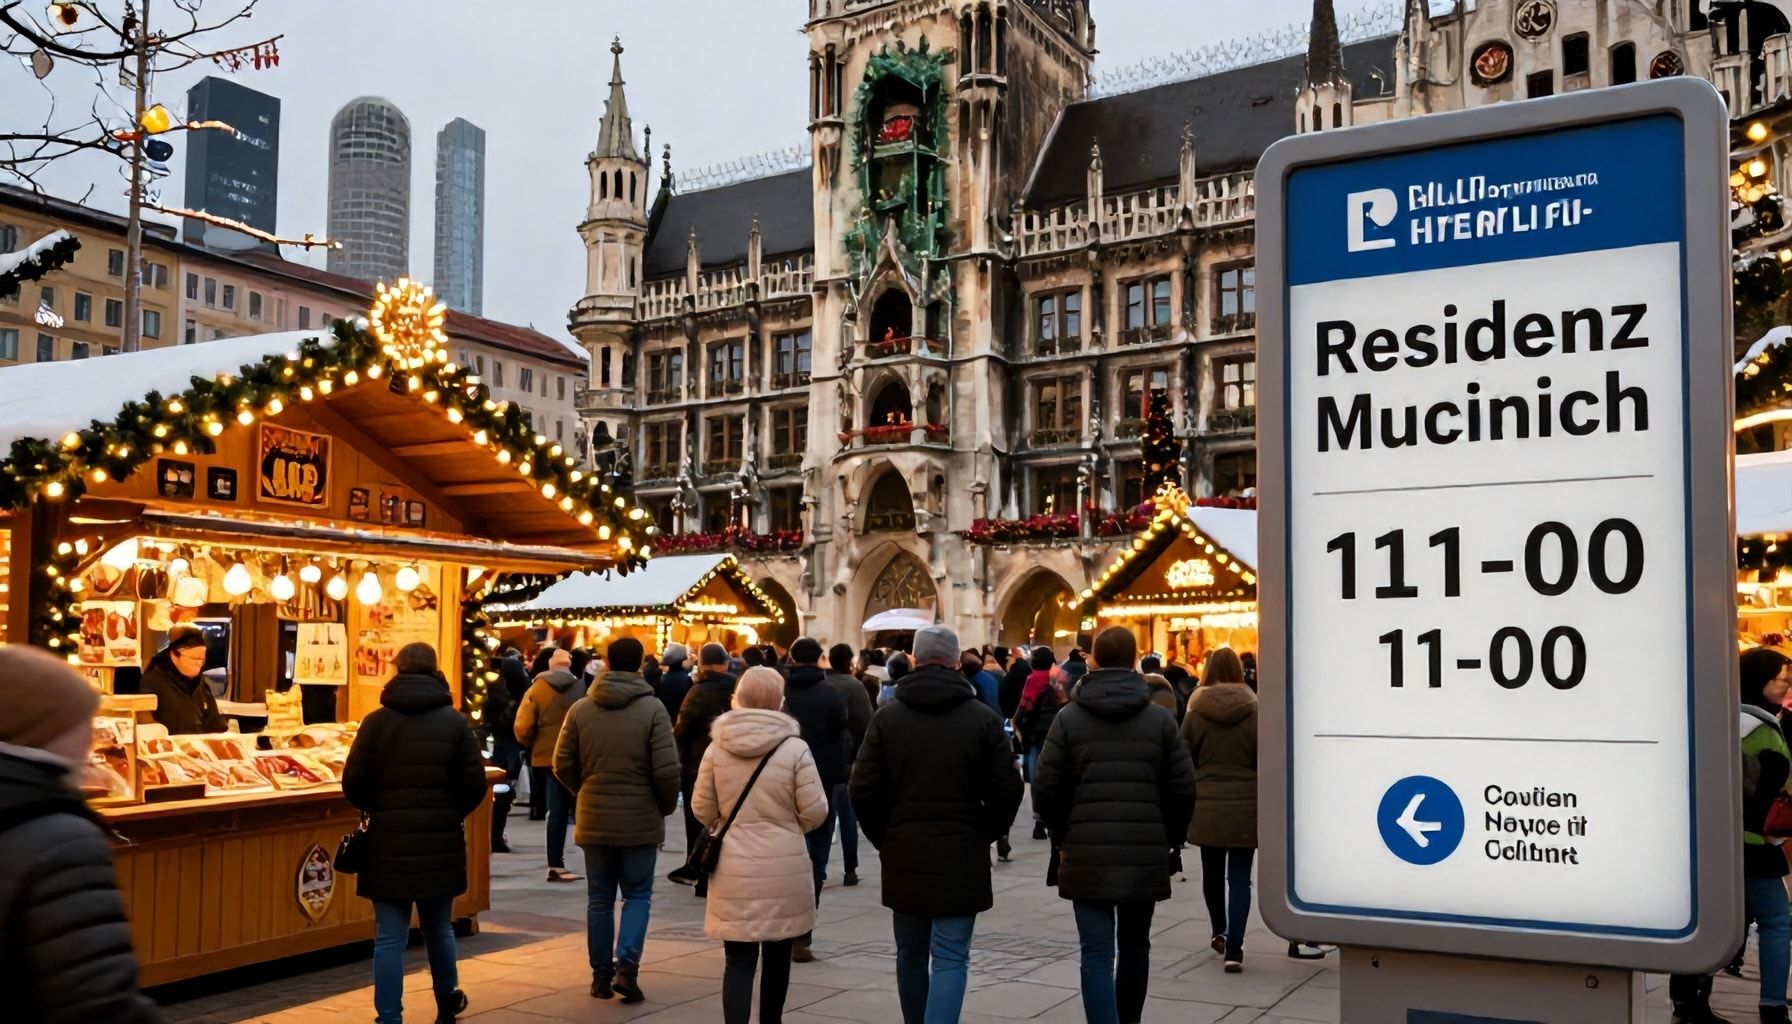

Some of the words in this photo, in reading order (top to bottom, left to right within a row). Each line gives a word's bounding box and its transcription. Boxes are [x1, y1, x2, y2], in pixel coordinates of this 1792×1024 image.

[1316, 299, 1650, 377] Residenz
[1317, 370, 1649, 453] Mucinich
[1326, 517, 1645, 600] 111-00
[1378, 625, 1587, 690] 11-00
